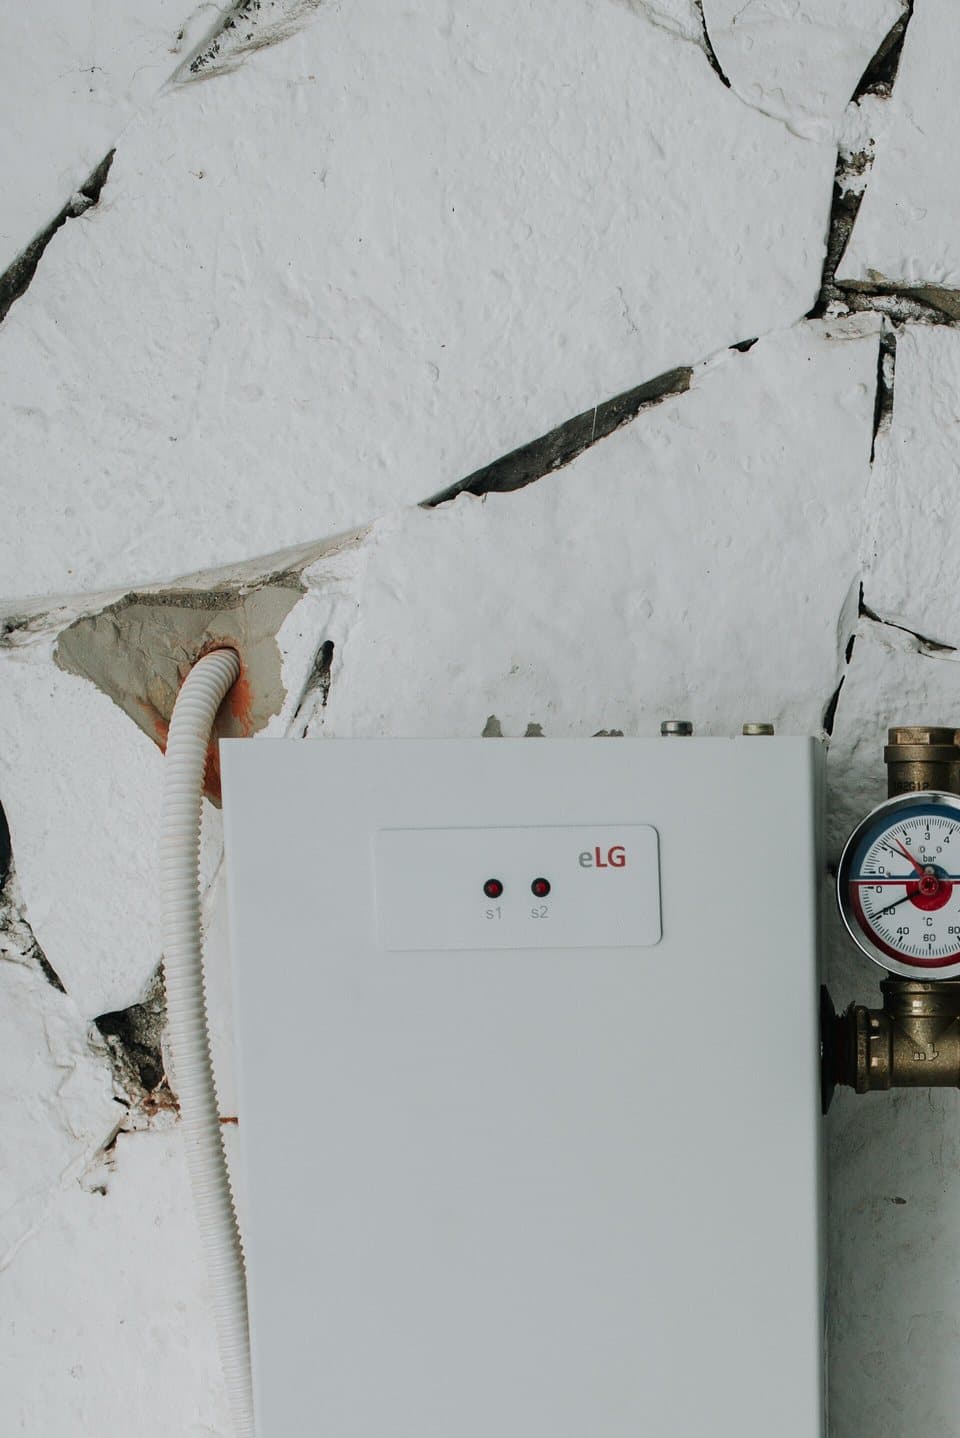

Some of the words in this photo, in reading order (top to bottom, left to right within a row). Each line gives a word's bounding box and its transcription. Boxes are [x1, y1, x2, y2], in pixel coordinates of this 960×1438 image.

[578, 845, 627, 868] eLG
[922, 854, 937, 863] bar
[485, 906, 503, 920] s1
[530, 904, 549, 919] s2
[882, 907, 896, 916] 20
[896, 926, 910, 936] 40
[948, 926, 960, 935] 80
[922, 934, 936, 942] 60
